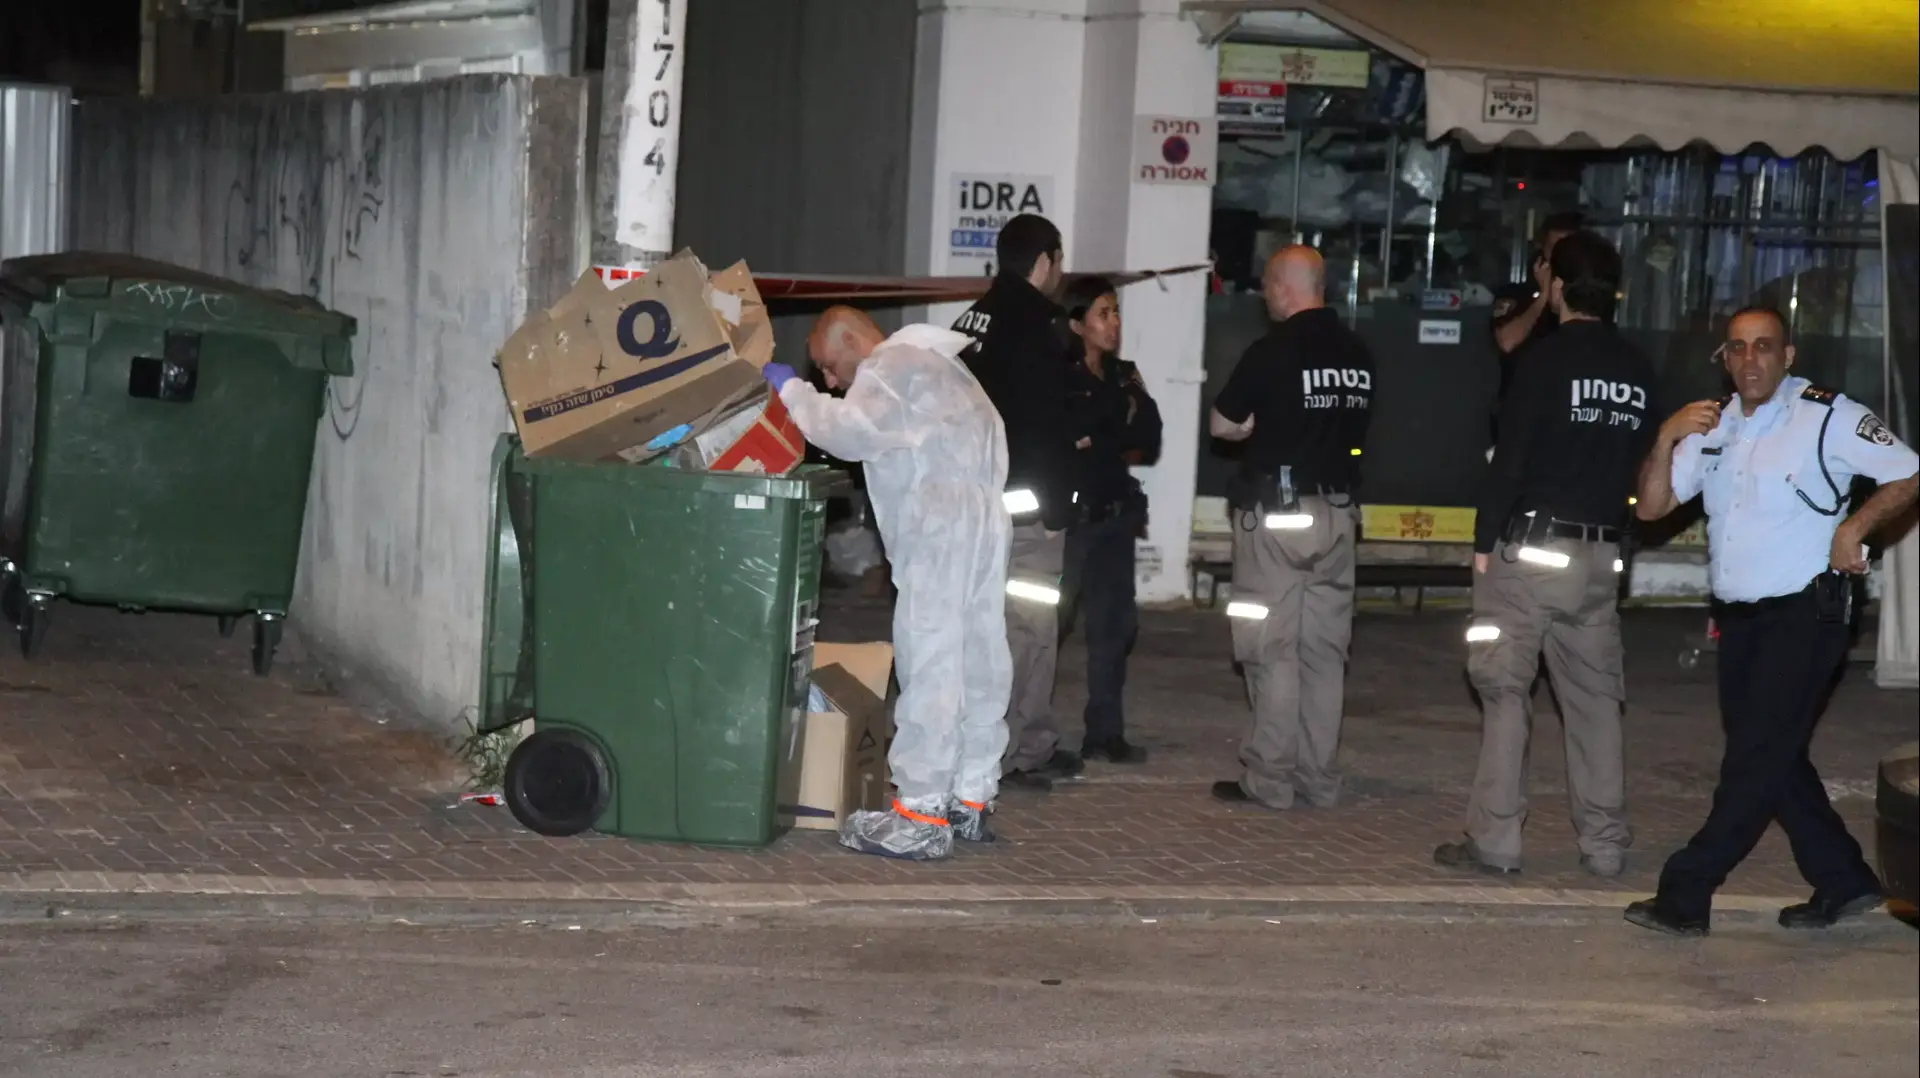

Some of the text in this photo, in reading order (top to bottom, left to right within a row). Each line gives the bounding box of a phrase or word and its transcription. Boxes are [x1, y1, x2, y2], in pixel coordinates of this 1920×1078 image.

[1152, 119, 1200, 135] חניה
[1141, 165, 1209, 181] אסורה
[960, 180, 1043, 213] iDRA
[1302, 367, 1371, 395] בטחון
[590, 384, 615, 403] סימן
[1304, 394, 1338, 409] רעננה
[1571, 379, 1646, 410] בטחון
